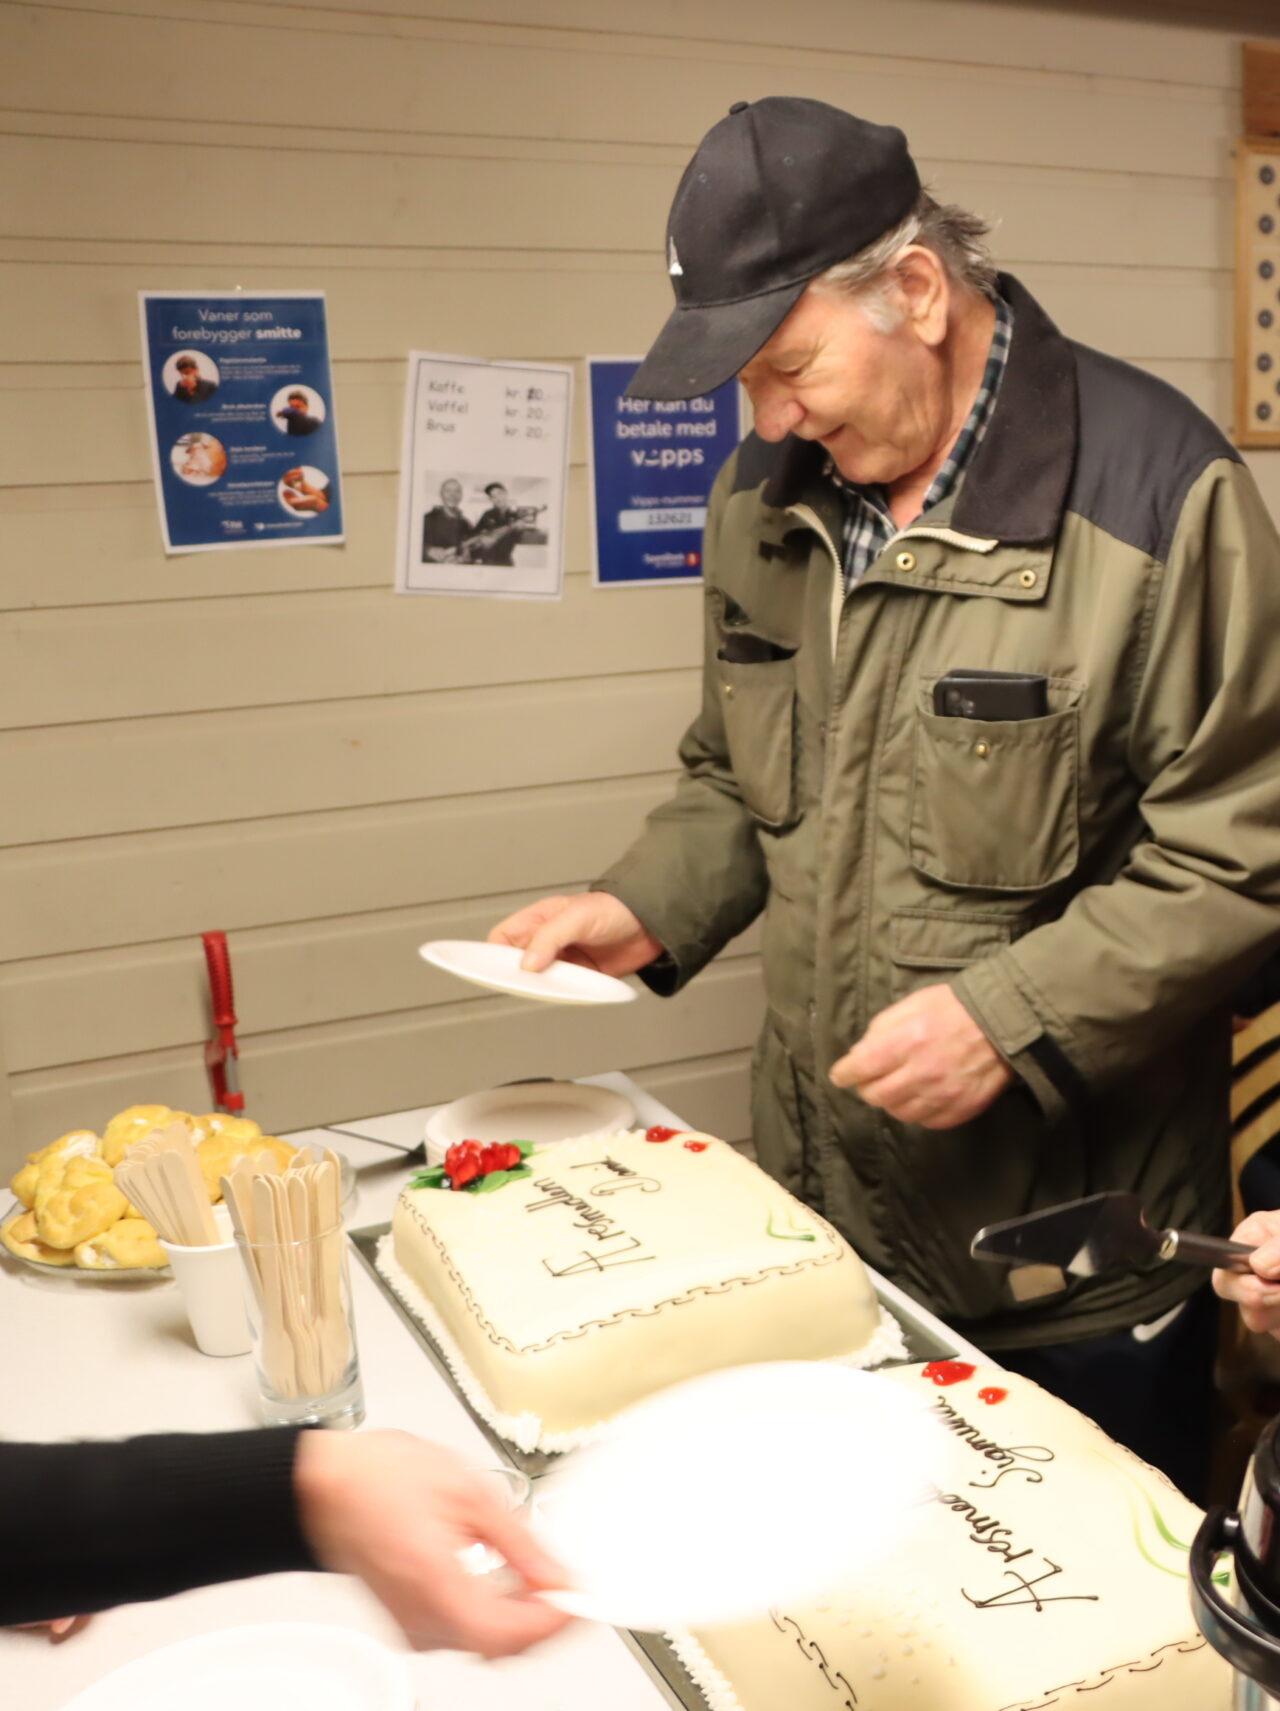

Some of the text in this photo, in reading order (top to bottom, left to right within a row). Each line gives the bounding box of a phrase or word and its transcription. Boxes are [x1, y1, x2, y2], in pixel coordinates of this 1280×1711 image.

[198, 308, 273, 321] Vaner som
[172, 326, 302, 342] forebygger smitte
[428, 380, 466, 395] Kaffe
[427, 400, 469, 414] Vaffel
[617, 397, 714, 412] Her kan du
[425, 419, 456, 433] Brus
[616, 419, 717, 438] betale med
